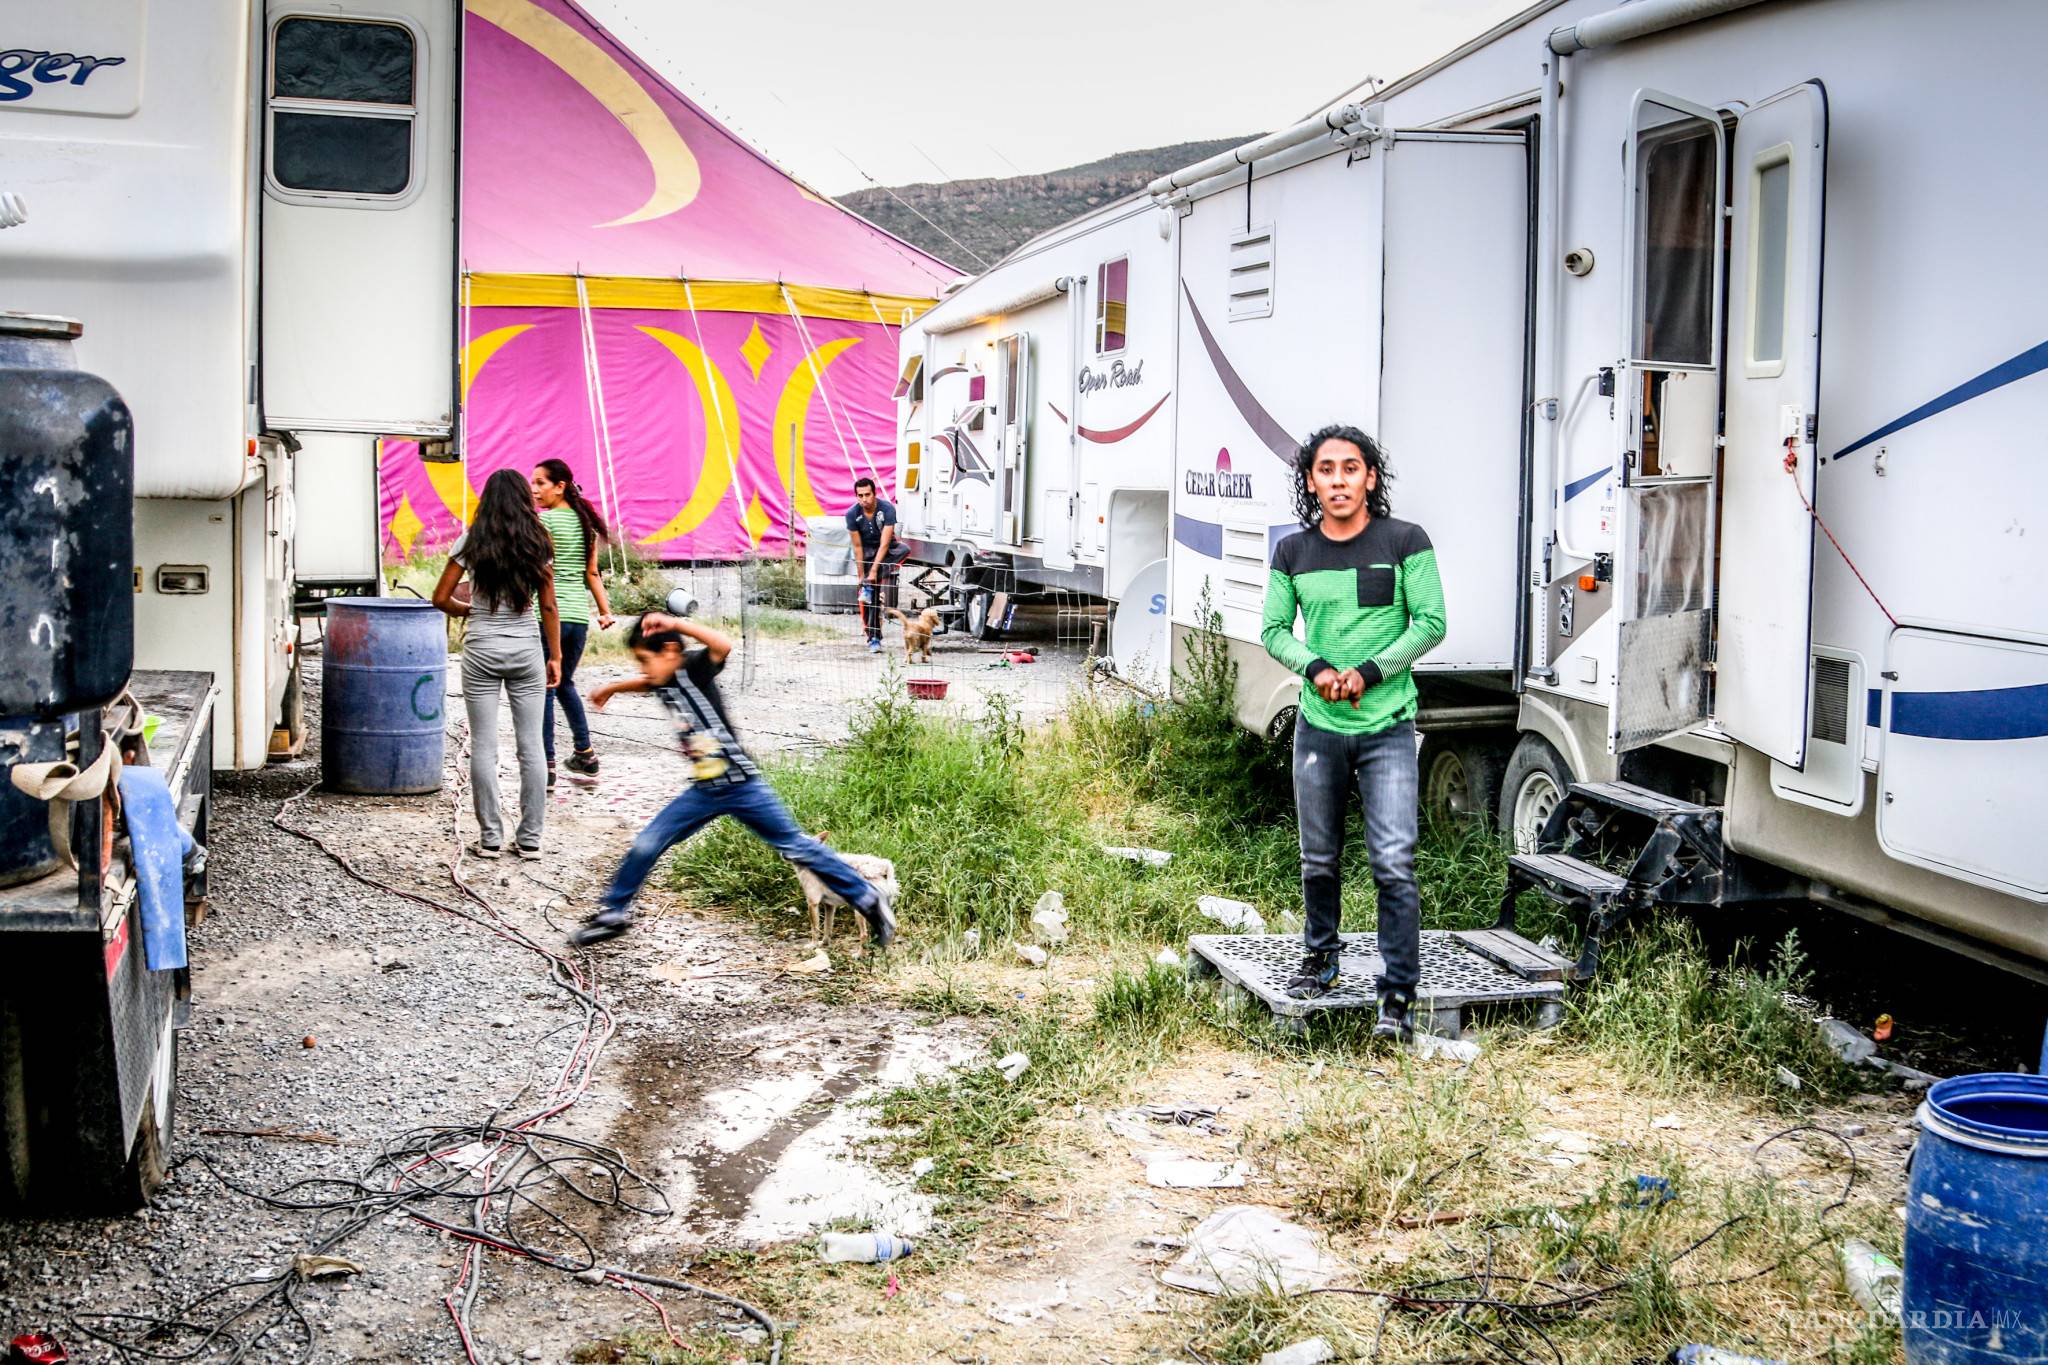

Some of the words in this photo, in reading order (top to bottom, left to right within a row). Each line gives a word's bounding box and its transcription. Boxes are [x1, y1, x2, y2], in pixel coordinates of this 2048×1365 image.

[1079, 365, 1108, 398] Open
[1110, 359, 1144, 388] Road
[1185, 469, 1216, 497] CEDAR
[1218, 471, 1252, 499] CREEK
[1149, 593, 1167, 615] S
